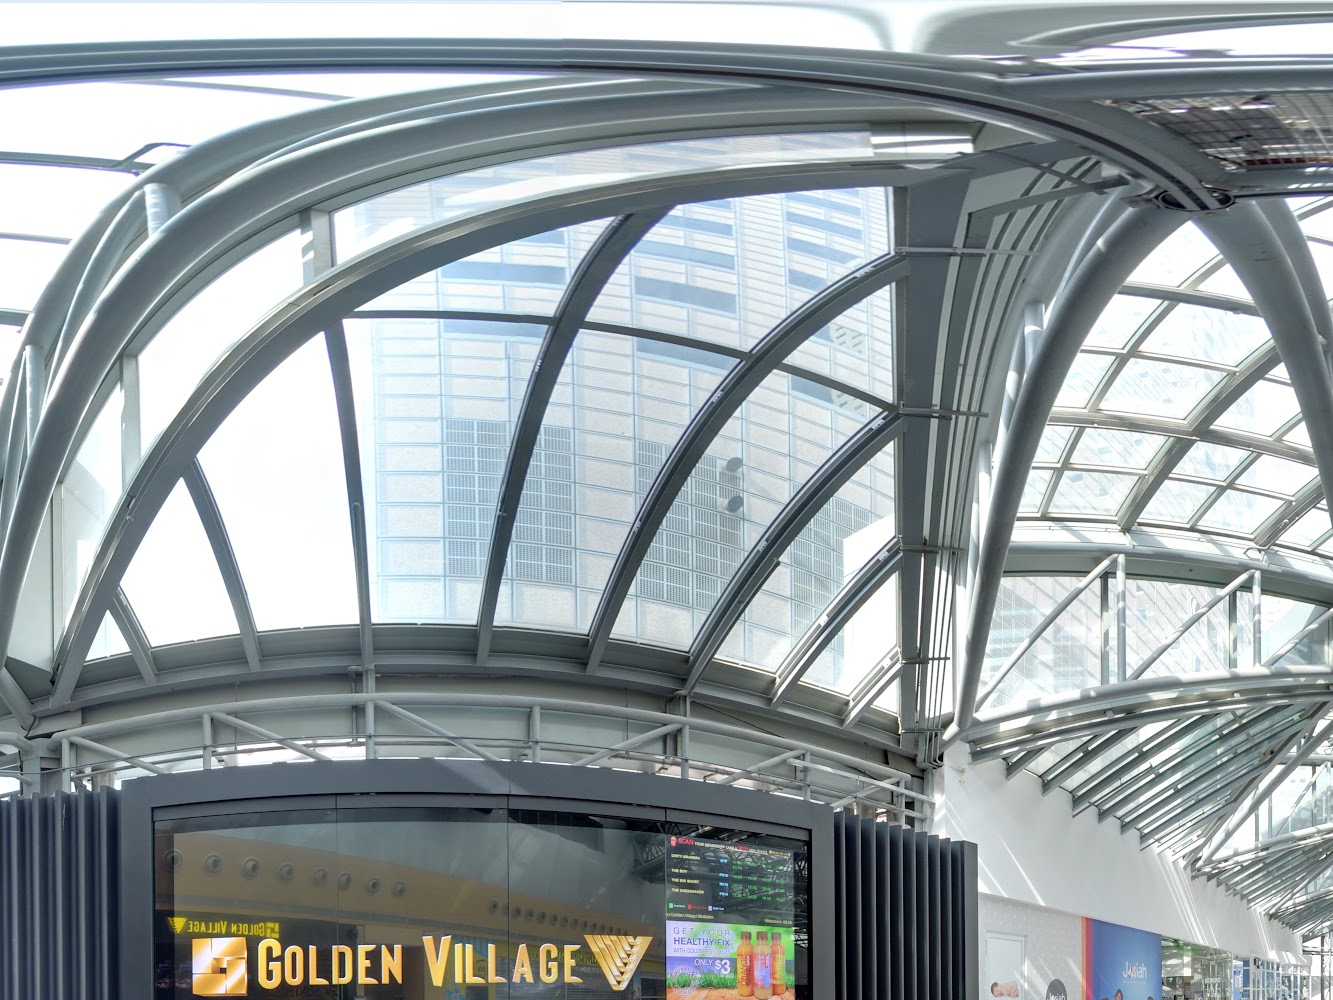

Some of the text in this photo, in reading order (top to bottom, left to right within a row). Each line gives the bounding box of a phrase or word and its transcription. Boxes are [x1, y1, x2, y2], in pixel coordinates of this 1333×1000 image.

[702, 928, 730, 936] YOUR
[674, 937, 730, 946] HEALTHY FIX
[258, 935, 584, 990] GOLDEN VILLAGE
[715, 960, 730, 974] $3
